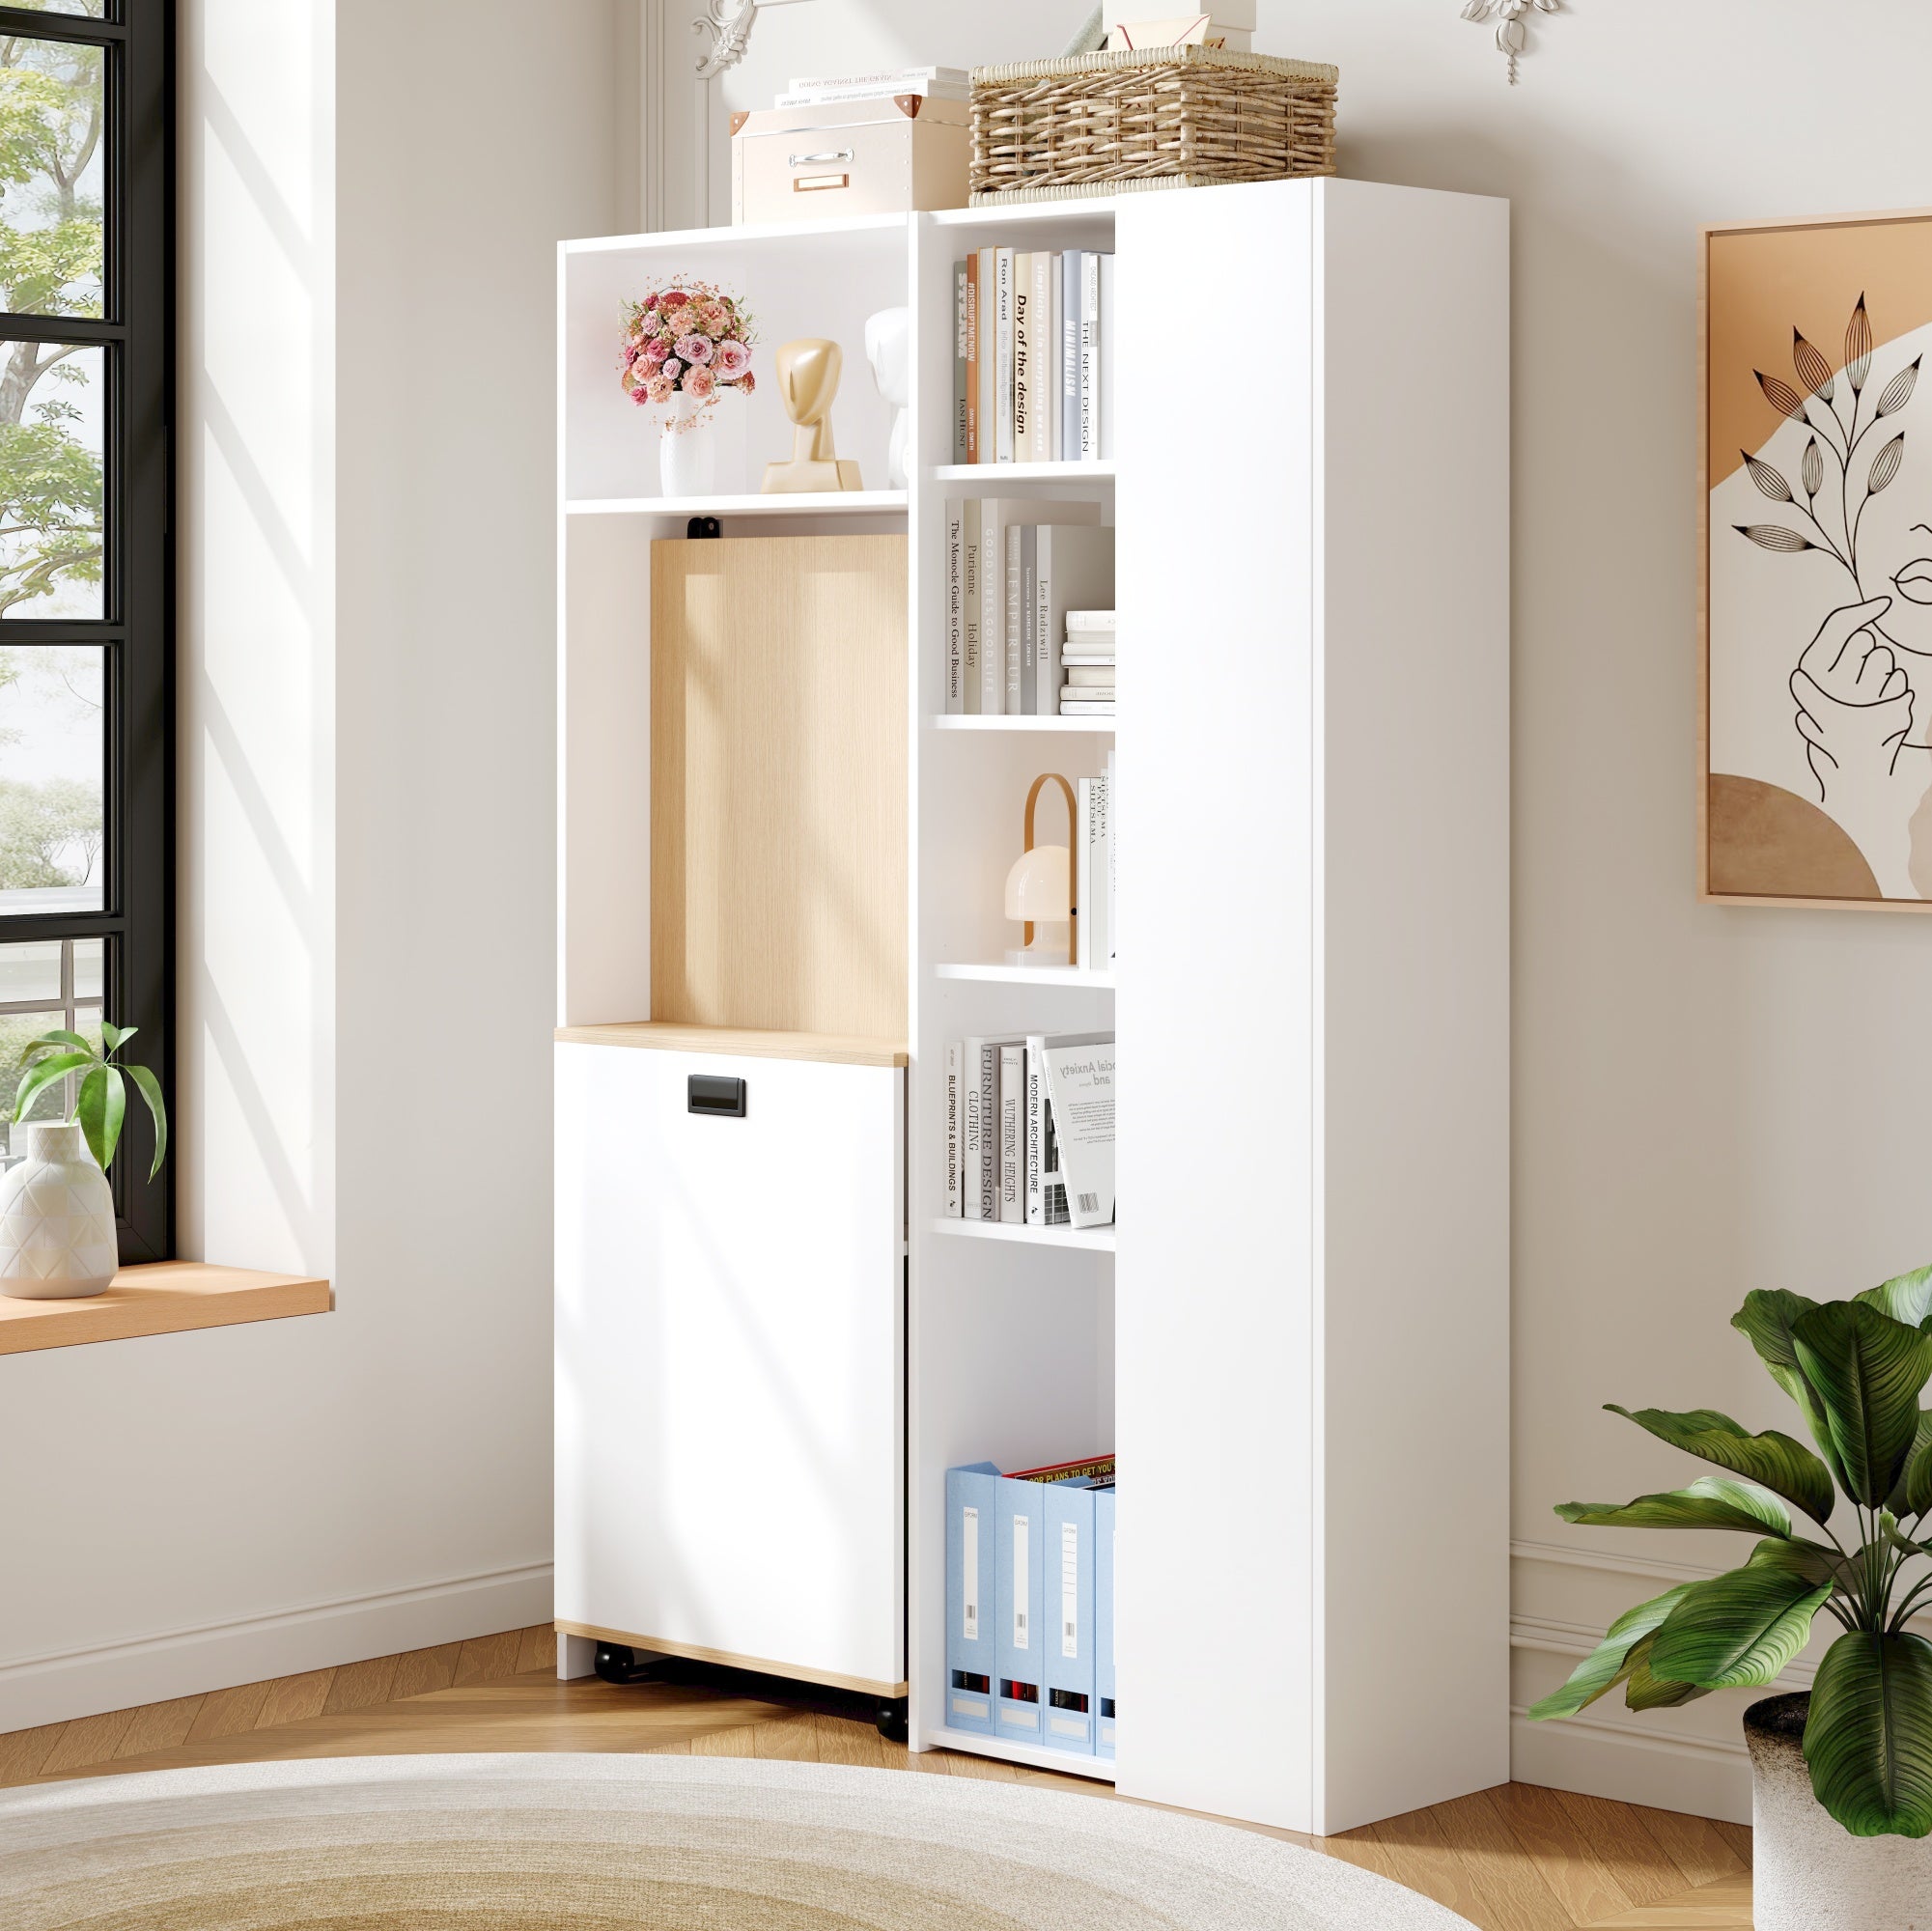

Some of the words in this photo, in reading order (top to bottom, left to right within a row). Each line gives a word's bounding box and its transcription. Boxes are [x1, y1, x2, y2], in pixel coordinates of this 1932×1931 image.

[1017, 294, 1027, 325] Day
[1017, 329, 1027, 347] of
[1065, 320, 1076, 397] MINIMALISM
[1018, 350, 1027, 377] the
[1016, 382, 1027, 434] design
[951, 520, 959, 540] The
[951, 543, 959, 583] Monocle
[968, 545, 977, 596] Purienne
[952, 617, 957, 627] to
[1040, 605, 1048, 659] Radziwill
[966, 624, 978, 668] Holiday
[982, 1049, 992, 1150] FURNITURE
[1030, 1074, 1038, 1116] MODERN
[969, 1091, 978, 1151] CLOTHING
[1005, 1099, 1015, 1157] WUTHERING
[1030, 1119, 1038, 1194] ARCHITECTURE
[982, 1156, 992, 1218] DESIGN
[1005, 1161, 1015, 1203] HEIGHTS
[1046, 1472, 1069, 1483] PLANS
[1071, 1469, 1080, 1478] TO
[1082, 1466, 1096, 1476] GET
